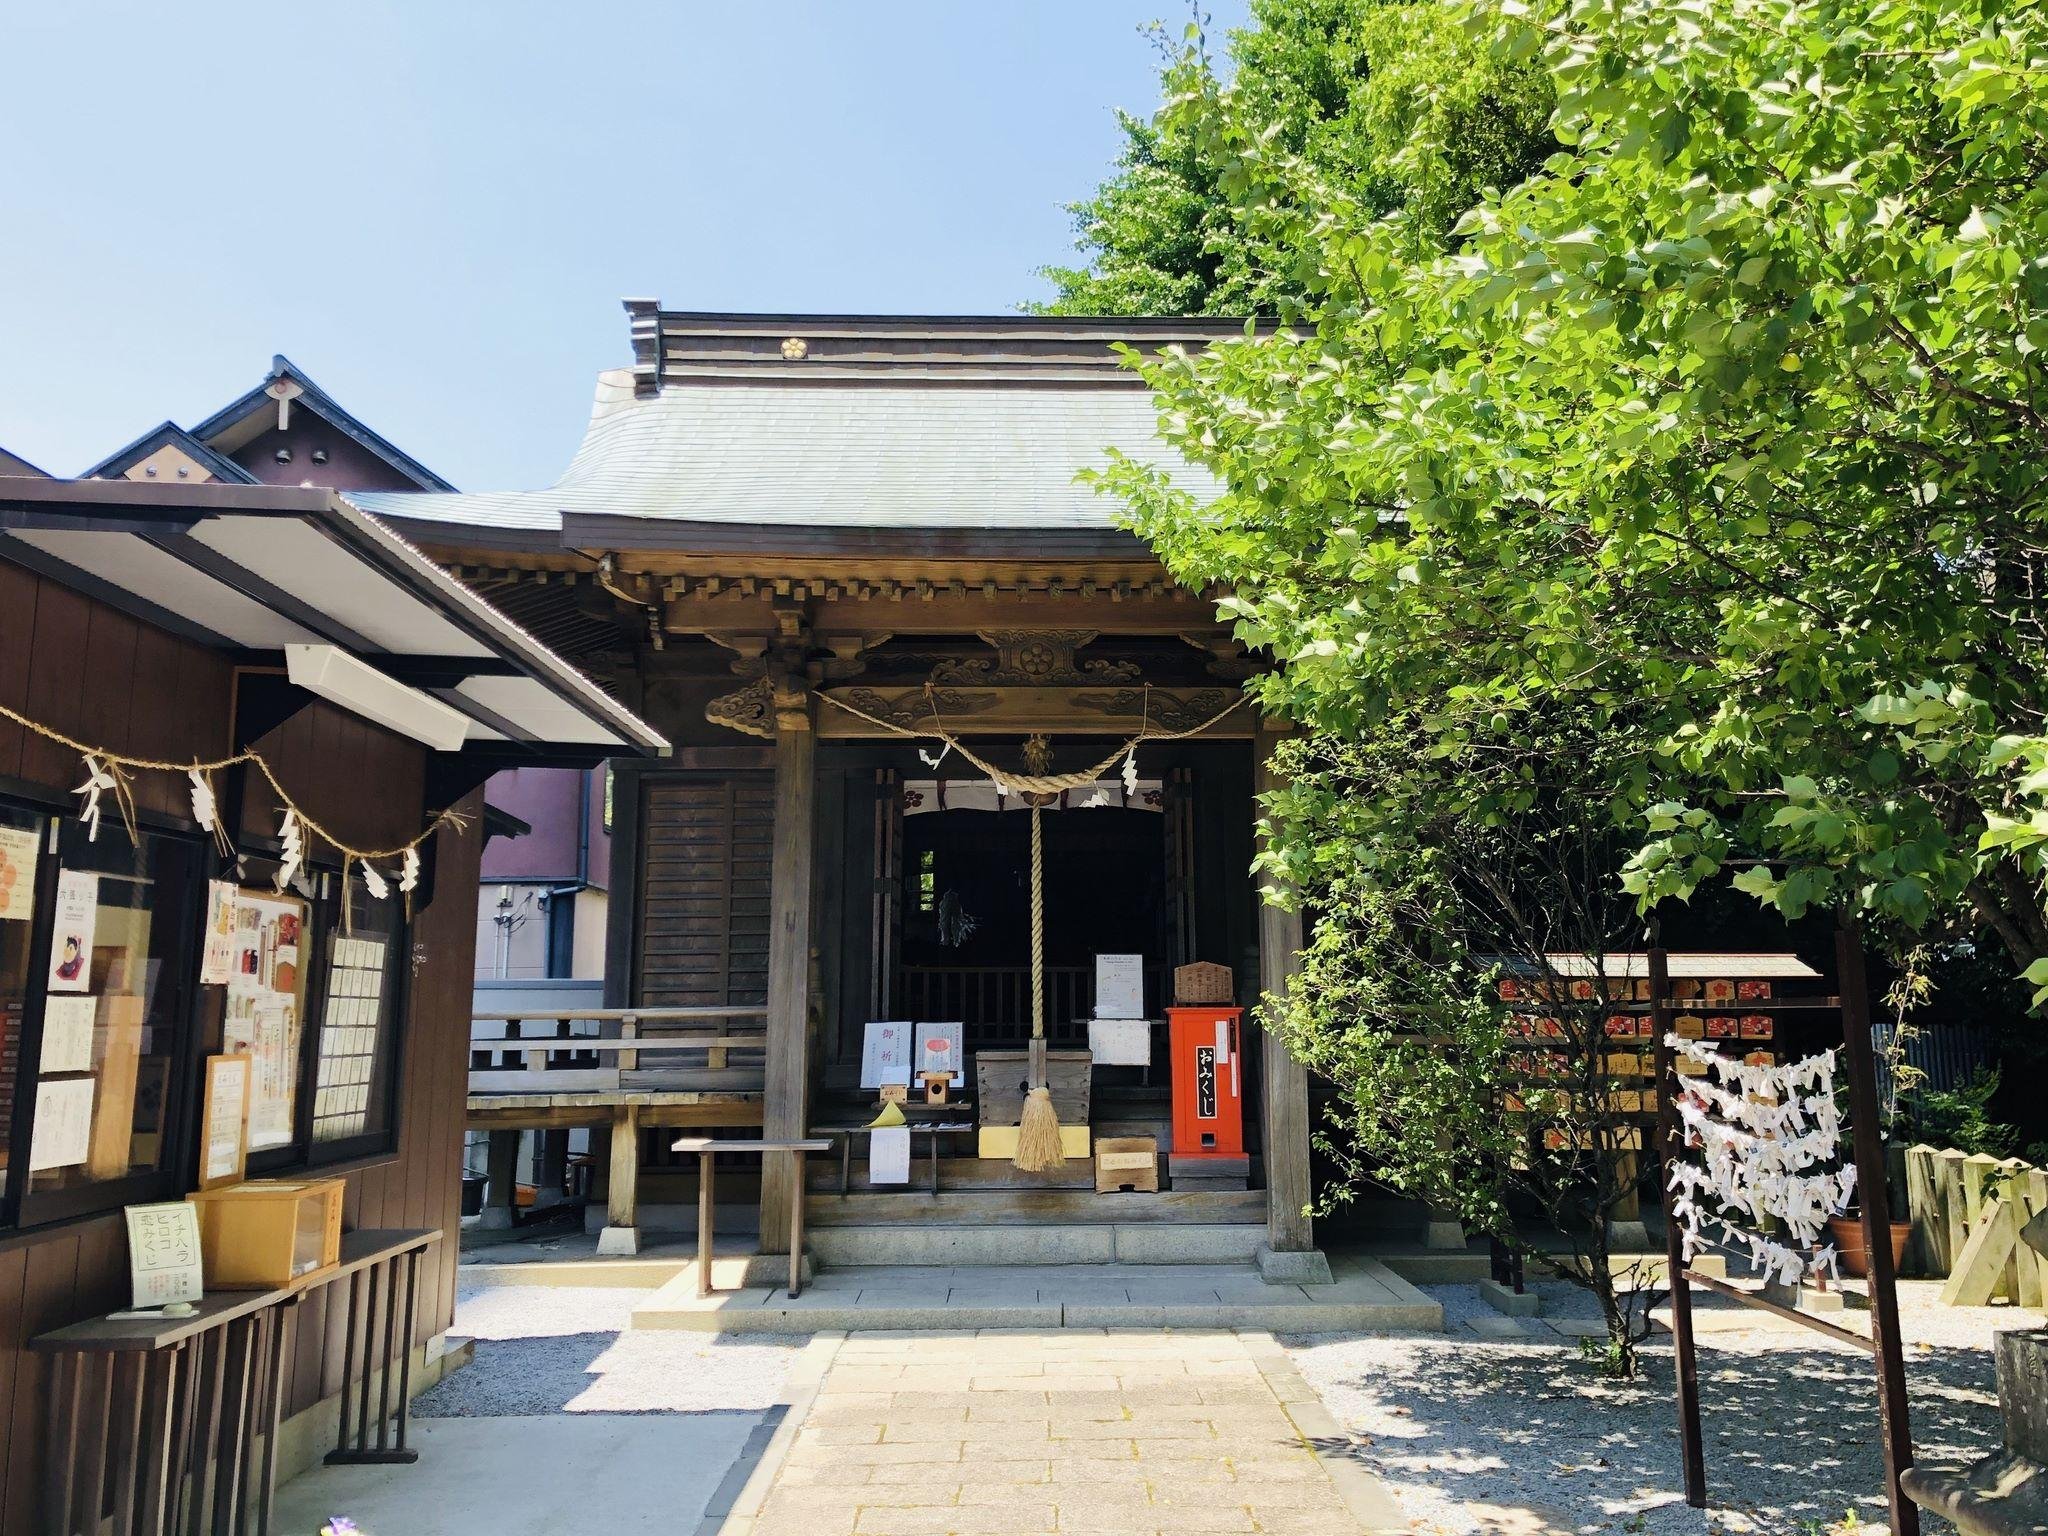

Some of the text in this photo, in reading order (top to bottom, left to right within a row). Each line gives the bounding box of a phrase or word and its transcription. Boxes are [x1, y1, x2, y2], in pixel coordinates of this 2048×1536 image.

[1198, 1049, 1213, 1116] おみくじ
[140, 1215, 157, 1266] 恋みくじ
[157, 1214, 171, 1250] ヒロコ
[172, 1213, 189, 1262] イチハラ
